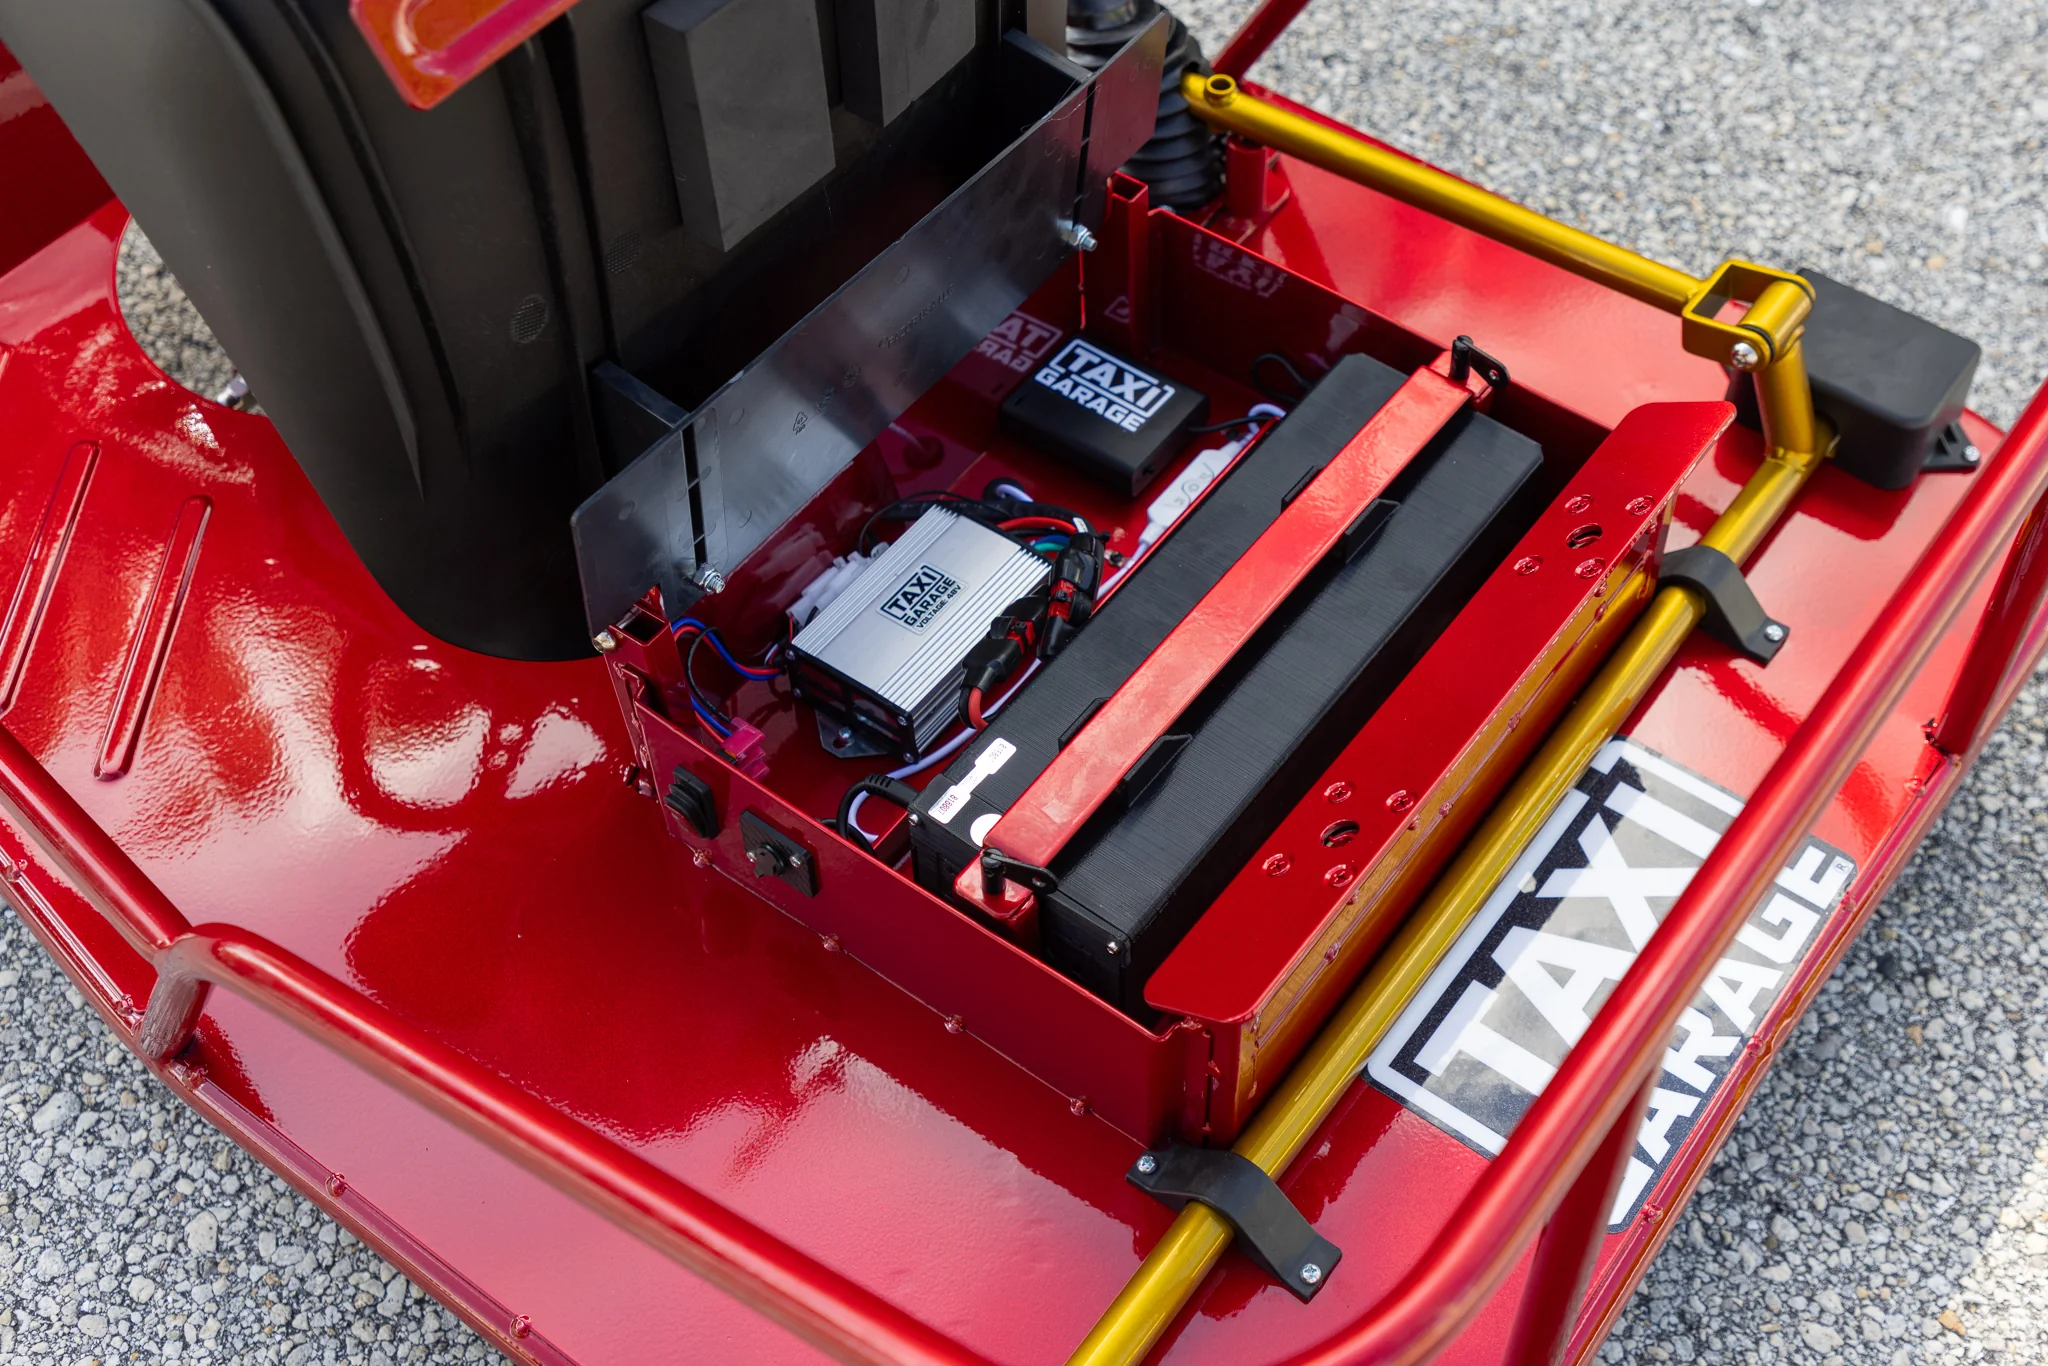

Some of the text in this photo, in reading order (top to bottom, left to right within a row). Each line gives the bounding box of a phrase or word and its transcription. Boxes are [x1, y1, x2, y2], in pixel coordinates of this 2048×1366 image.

[1034, 367, 1147, 433] GARAGE
[1067, 346, 1162, 409] TAXI
[887, 571, 938, 612] TAXI
[903, 576, 956, 627] GARAGE
[916, 584, 962, 628] VOLTAGE: 48V
[1413, 781, 1722, 1097] TAXI
